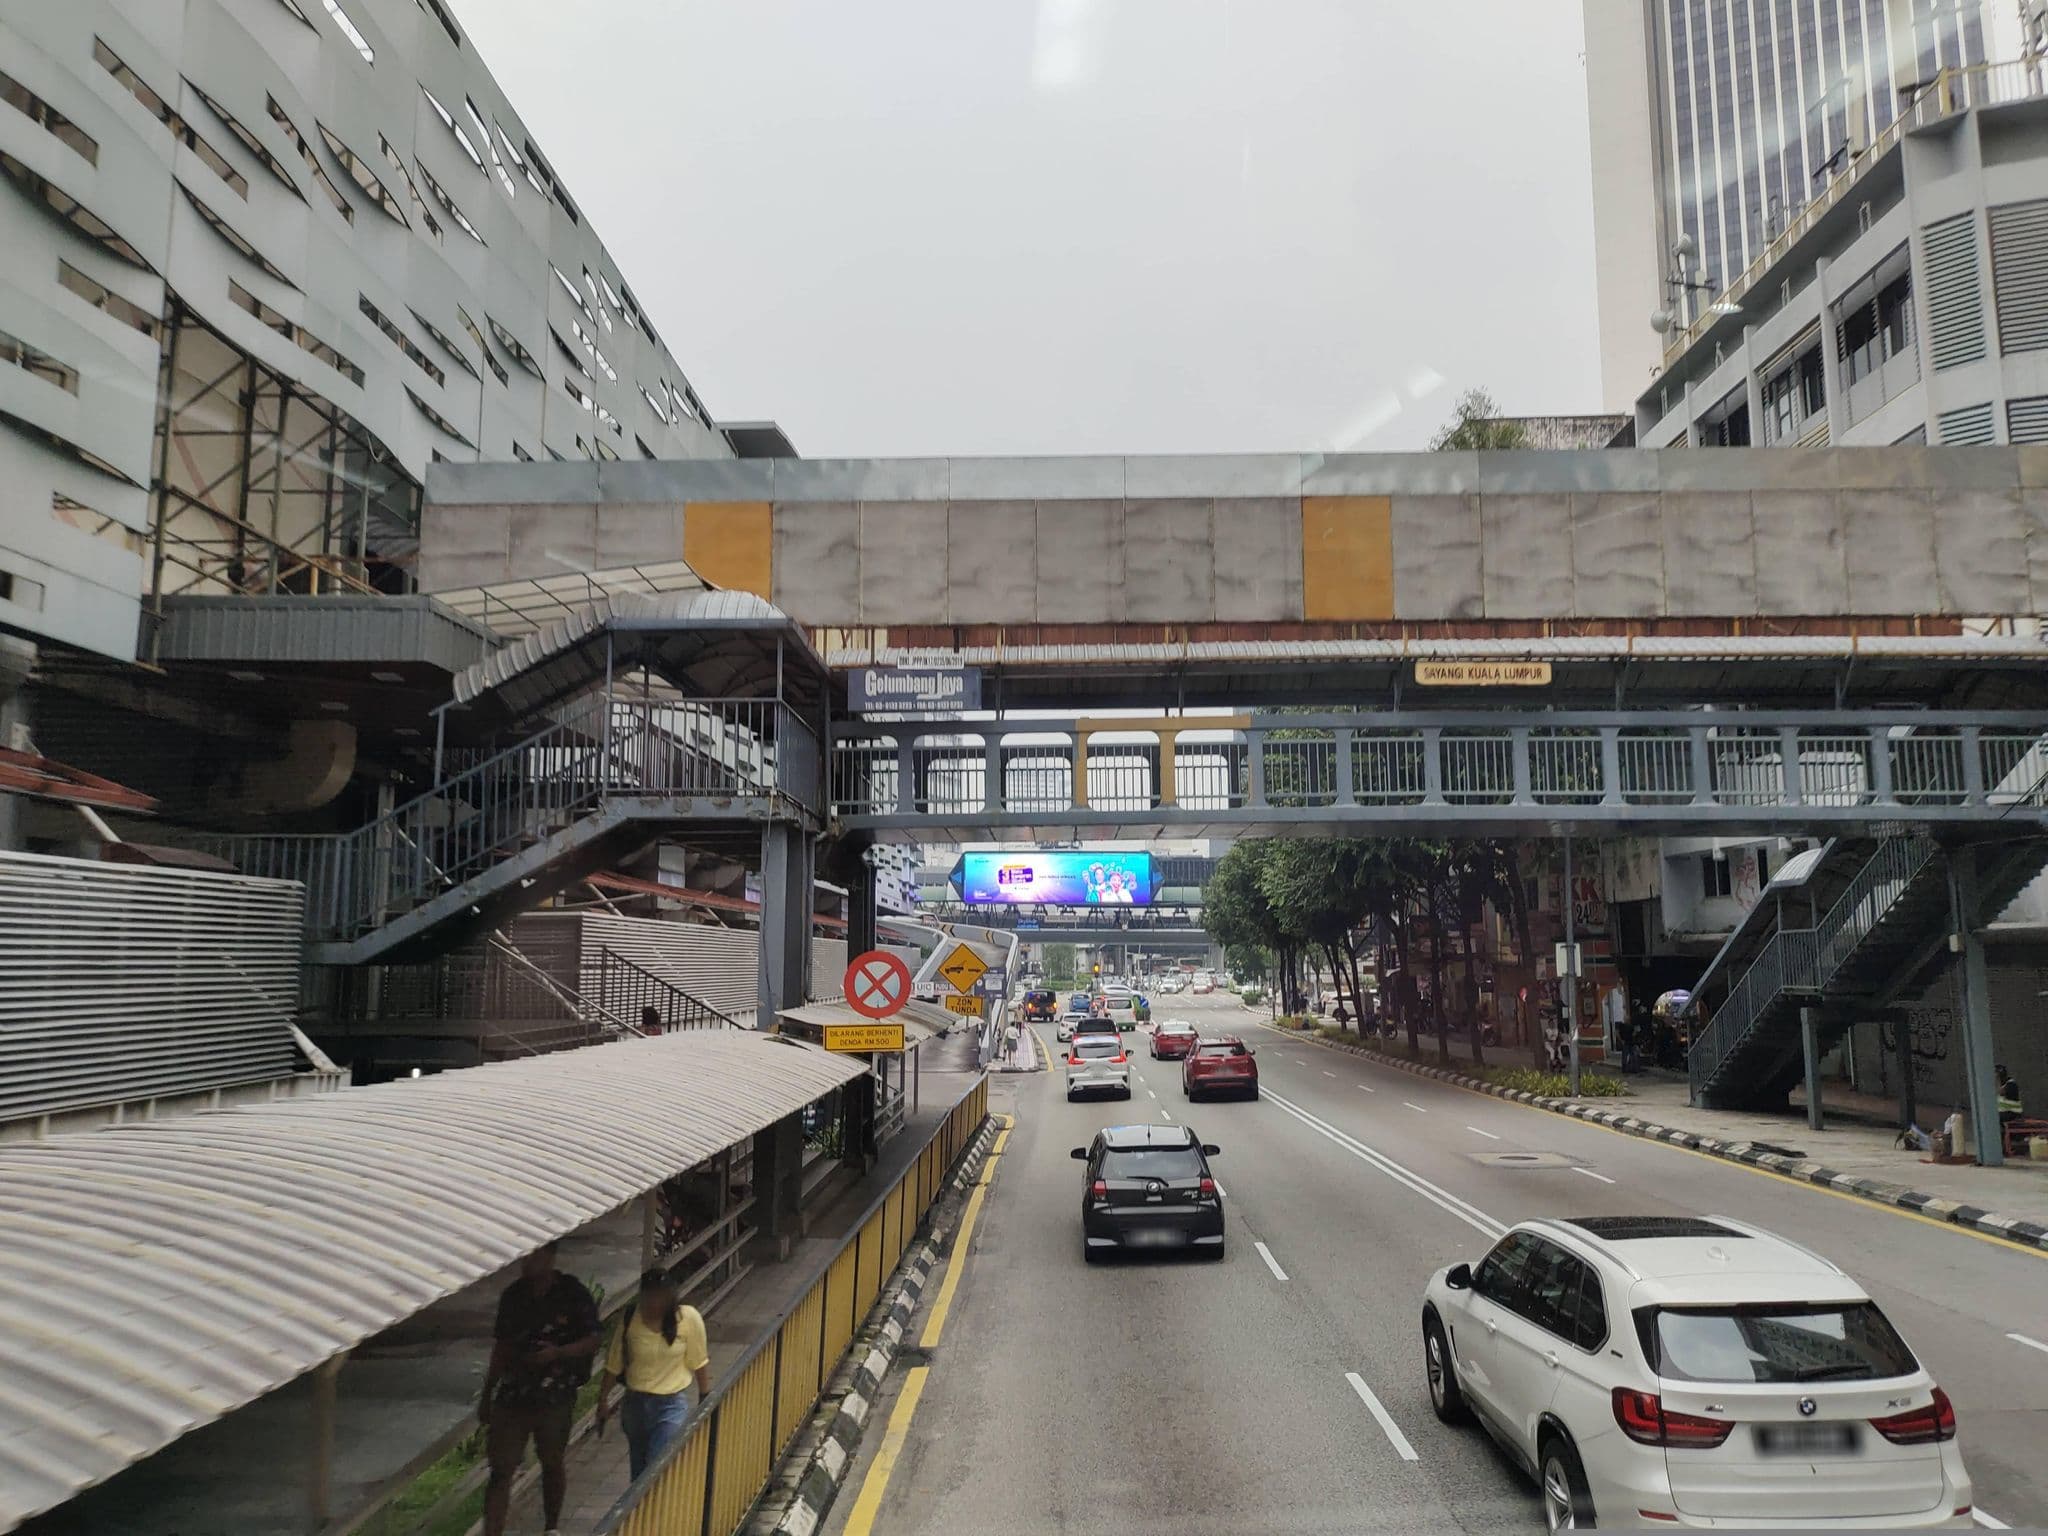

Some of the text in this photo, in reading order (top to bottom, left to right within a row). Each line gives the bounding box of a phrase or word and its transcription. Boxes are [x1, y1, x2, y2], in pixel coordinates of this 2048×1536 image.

[1424, 667, 1542, 679] SAYANGI KUALA LUMPUR
[956, 998, 972, 1006] ZON
[951, 1005, 977, 1014] TUNDA
[866, 1029, 899, 1037] BERHENTI
